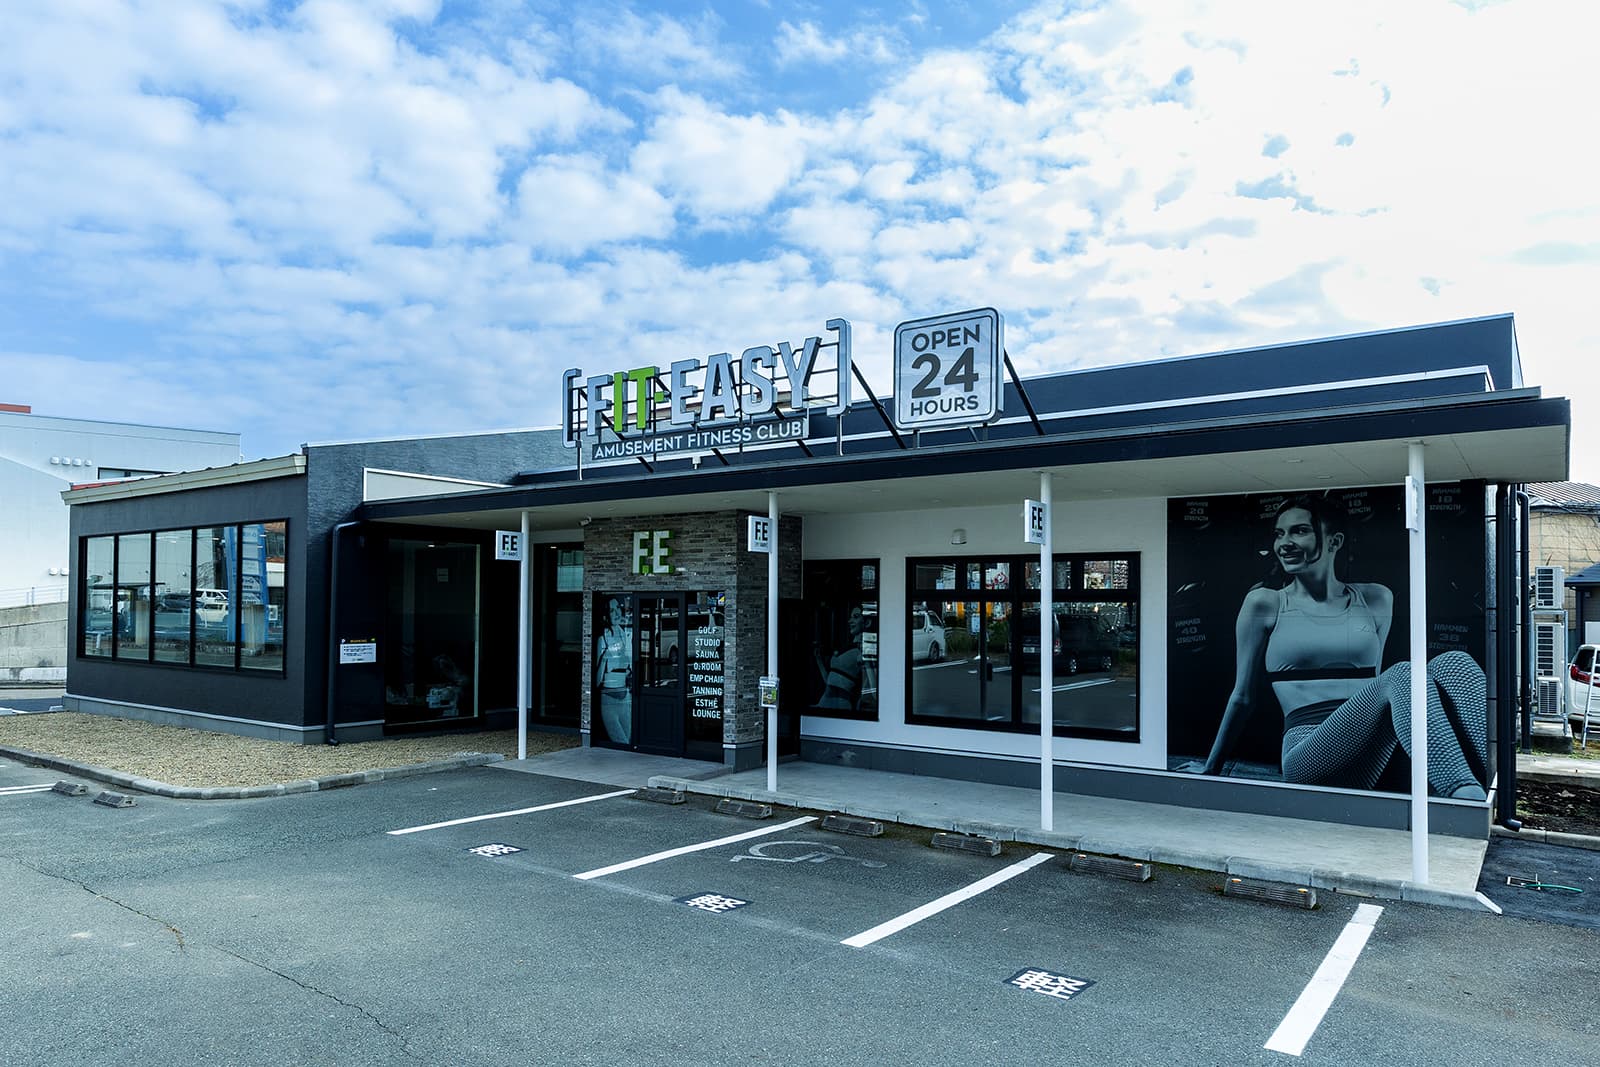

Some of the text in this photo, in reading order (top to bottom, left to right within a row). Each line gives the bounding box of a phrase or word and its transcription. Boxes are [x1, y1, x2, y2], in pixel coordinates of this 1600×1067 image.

[911, 324, 980, 352] OPEN
[911, 347, 979, 399] 24
[910, 395, 979, 416] HOURS
[594, 421, 802, 459] AMUSEMENT FITNESS CLUB
[698, 626, 717, 634] GOLF
[694, 638, 721, 647] STUDIO
[695, 650, 720, 659] SAUNA
[689, 673, 704, 682] EMP
[692, 686, 723, 696] TANNING
[692, 708, 721, 719] LOUNGE
[684, 894, 746, 914] 軽
[1010, 969, 1088, 1001] 軽
